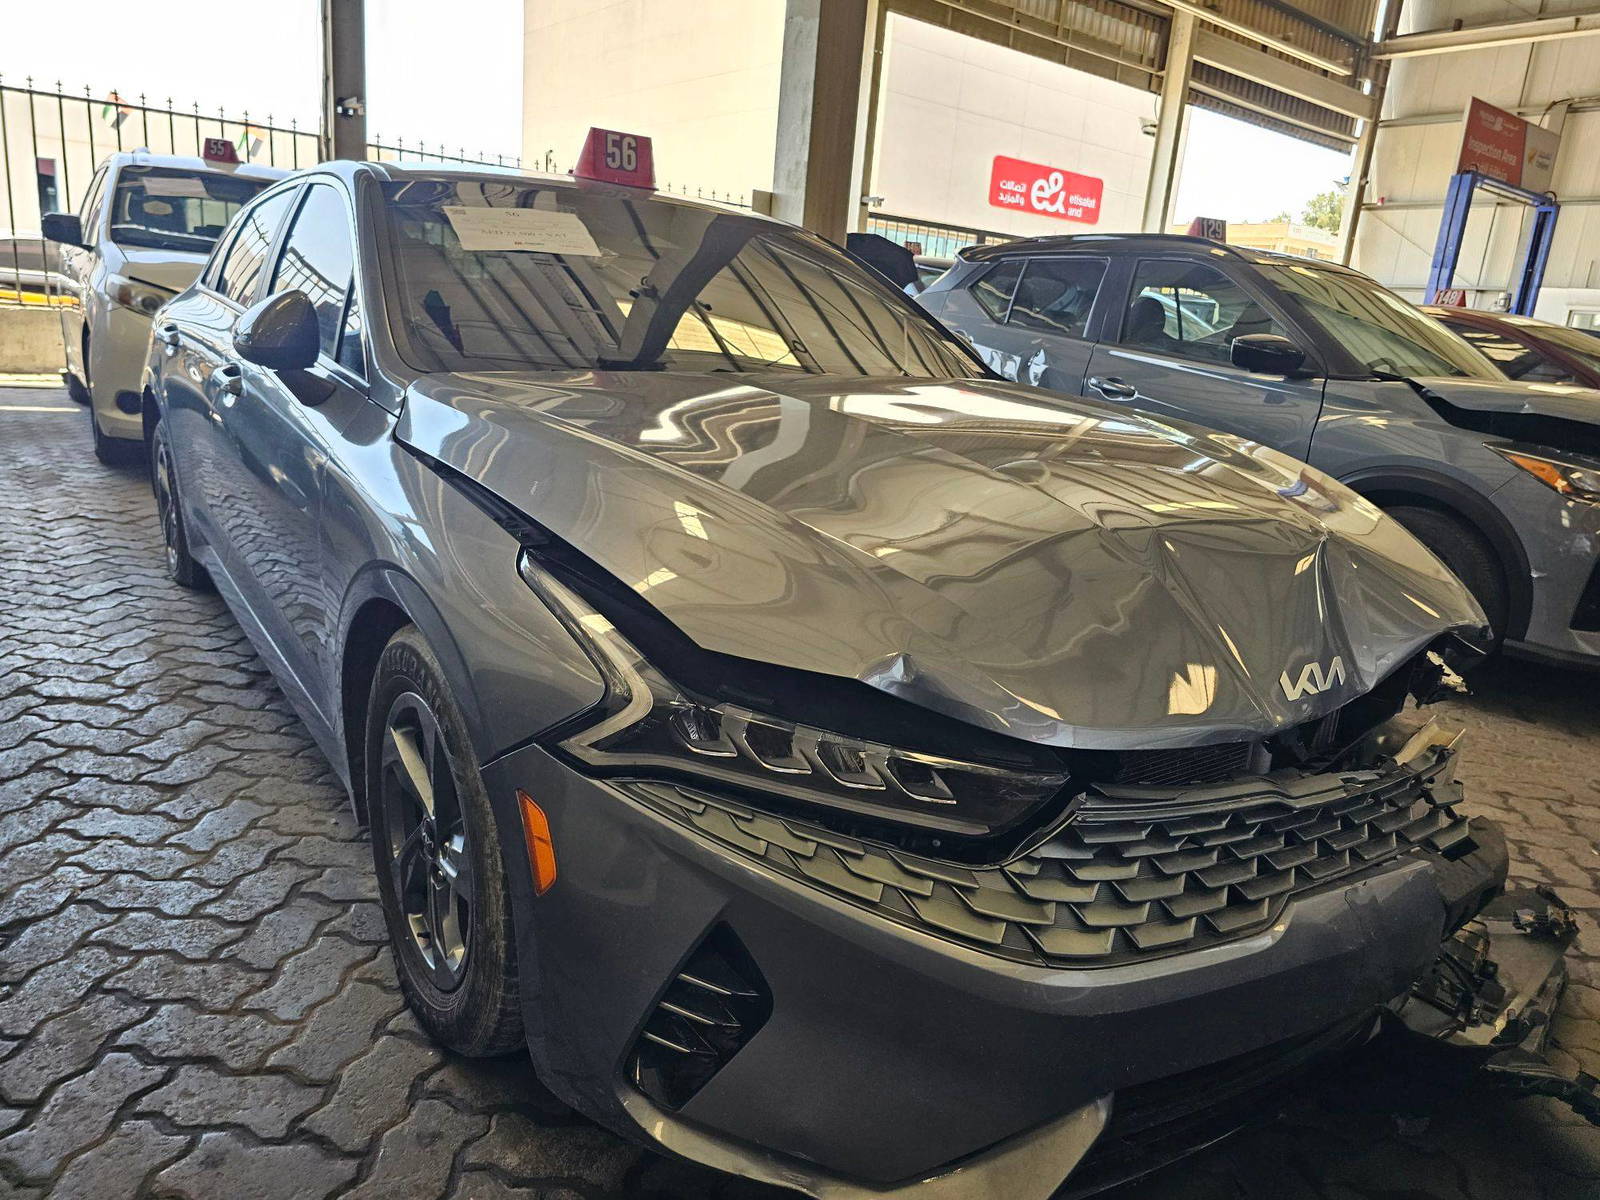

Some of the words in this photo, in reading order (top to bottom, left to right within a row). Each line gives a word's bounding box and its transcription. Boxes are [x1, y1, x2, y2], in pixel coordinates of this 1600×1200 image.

[210, 139, 225, 156] 55
[607, 133, 637, 171] 56
[1000, 180, 1027, 193] اتصالات
[998, 191, 1025, 206] والمزيد
[1069, 194, 1097, 208] etisalat
[1067, 207, 1083, 218] and
[1203, 219, 1223, 239] 129
[1437, 289, 1457, 304] 148
[1279, 655, 1346, 702] KIA
